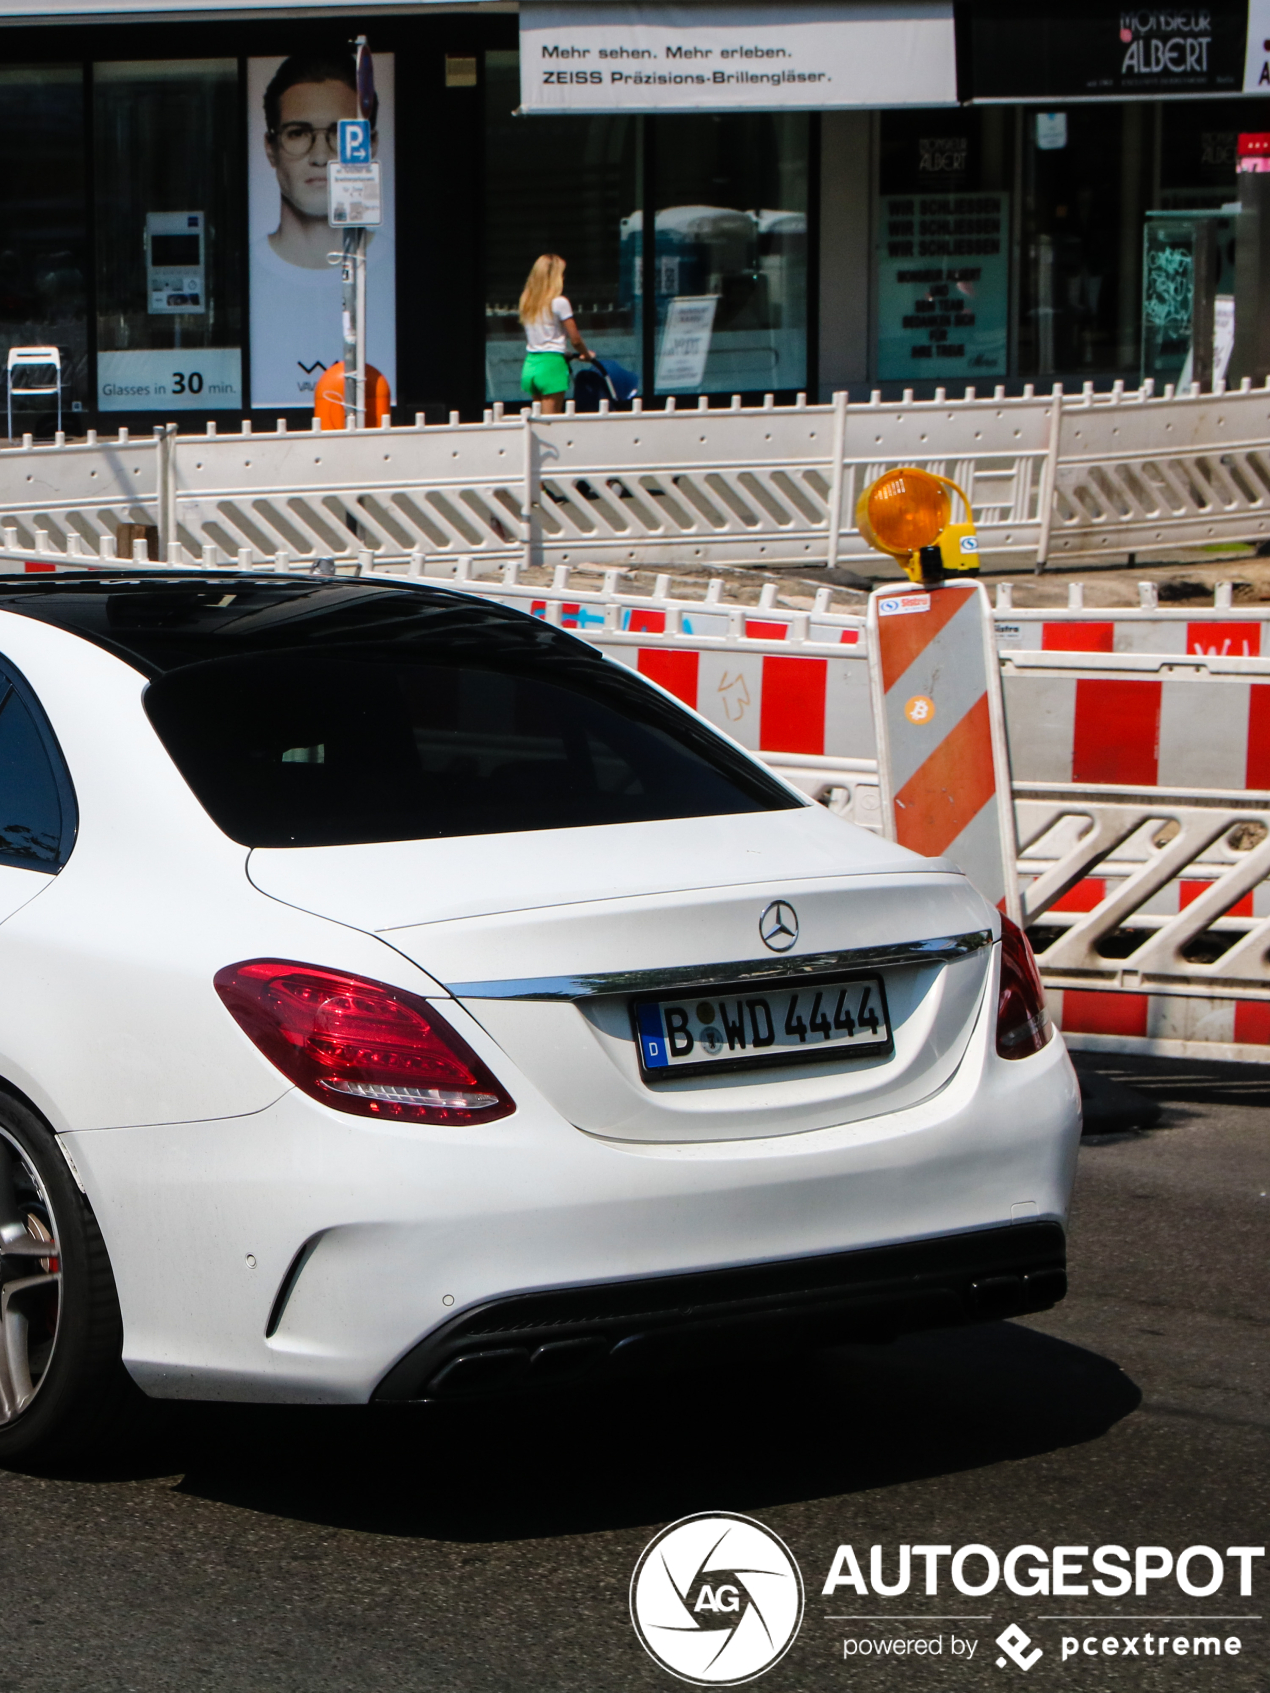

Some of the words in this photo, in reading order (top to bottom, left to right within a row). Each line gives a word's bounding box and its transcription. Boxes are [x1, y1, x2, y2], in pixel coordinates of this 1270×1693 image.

[1120, 10, 1212, 32] MONSIEUR
[541, 46, 591, 59] Mehr
[598, 46, 658, 59] sehen.
[665, 46, 713, 59] Mehr
[720, 46, 792, 59] erleben.
[1121, 37, 1212, 74] ALBERT
[542, 71, 603, 84] ZEISS
[611, 69, 832, 86] Präzisions-Brillengläser.
[345, 125, 363, 159] P
[919, 152, 967, 171] ALBERT
[102, 383, 150, 396] Glasses
[155, 383, 166, 395] in
[171, 372, 203, 394] 30
[208, 383, 236, 395] min.
[664, 1007, 694, 1057] B
[719, 999, 776, 1050] WD
[784, 987, 879, 1042] 4444
[649, 1042, 659, 1056] D
